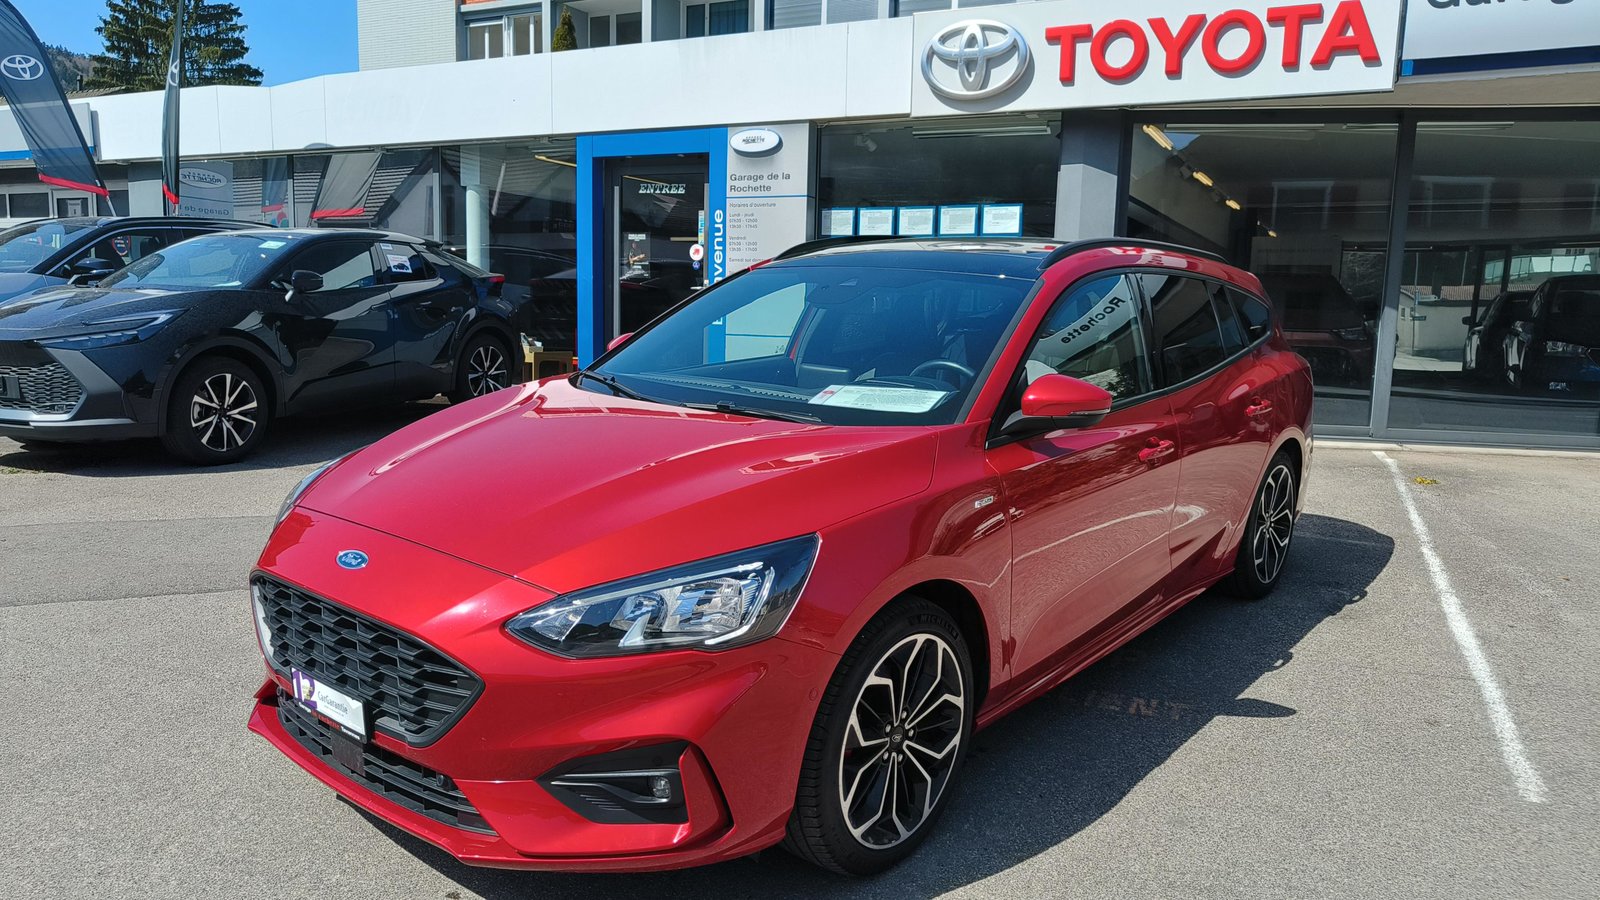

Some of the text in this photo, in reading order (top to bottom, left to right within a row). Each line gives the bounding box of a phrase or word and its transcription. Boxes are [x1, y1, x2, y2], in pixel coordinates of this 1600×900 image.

[1045, 0, 1382, 83] TOYOTA
[730, 172, 791, 182] Garage de la
[638, 183, 686, 194] ENTREE
[730, 184, 772, 192] Rochette
